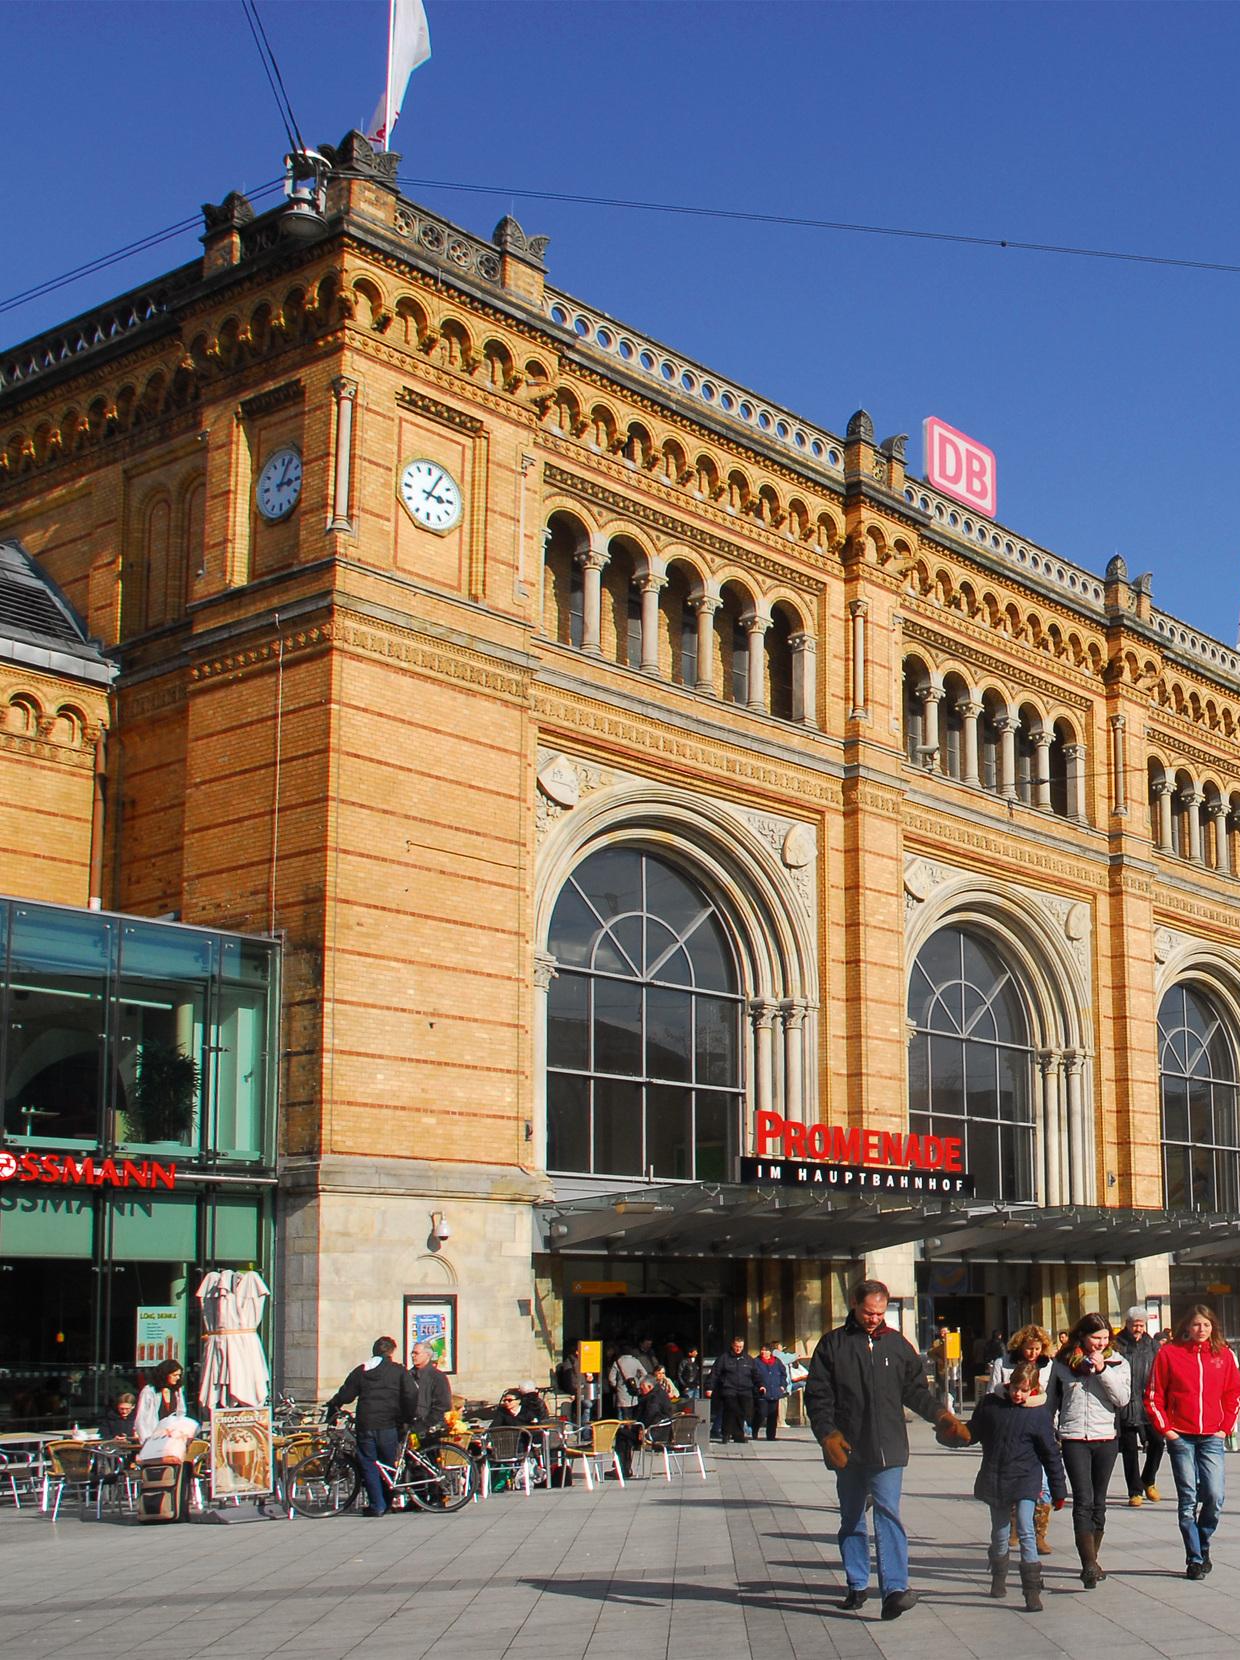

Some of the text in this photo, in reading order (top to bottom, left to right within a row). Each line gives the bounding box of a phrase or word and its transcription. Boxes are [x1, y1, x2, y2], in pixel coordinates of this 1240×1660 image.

[938, 431, 989, 500] DB
[756, 1110, 962, 1172] PROMENADE
[757, 1165, 963, 1192] IM HAUPTBAHNHOF
